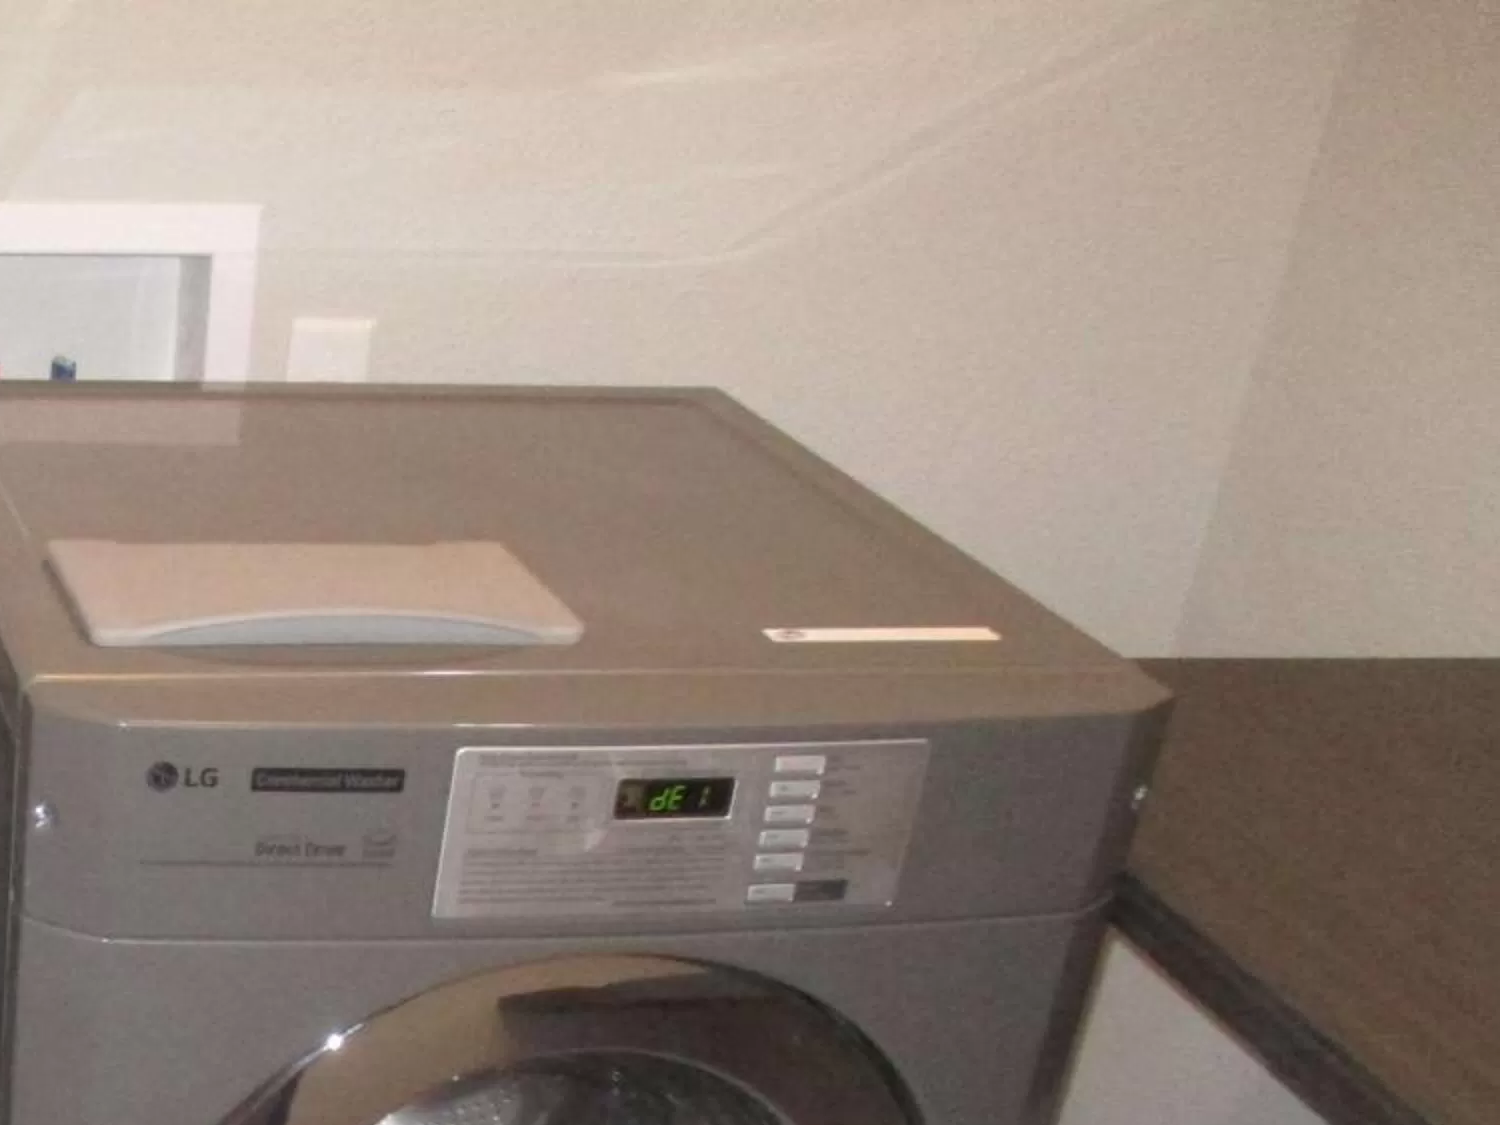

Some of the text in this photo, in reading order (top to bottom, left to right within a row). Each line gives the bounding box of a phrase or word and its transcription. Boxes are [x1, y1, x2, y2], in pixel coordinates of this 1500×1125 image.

[184, 767, 220, 788] LG
[256, 771, 400, 788] Commercial Washer
